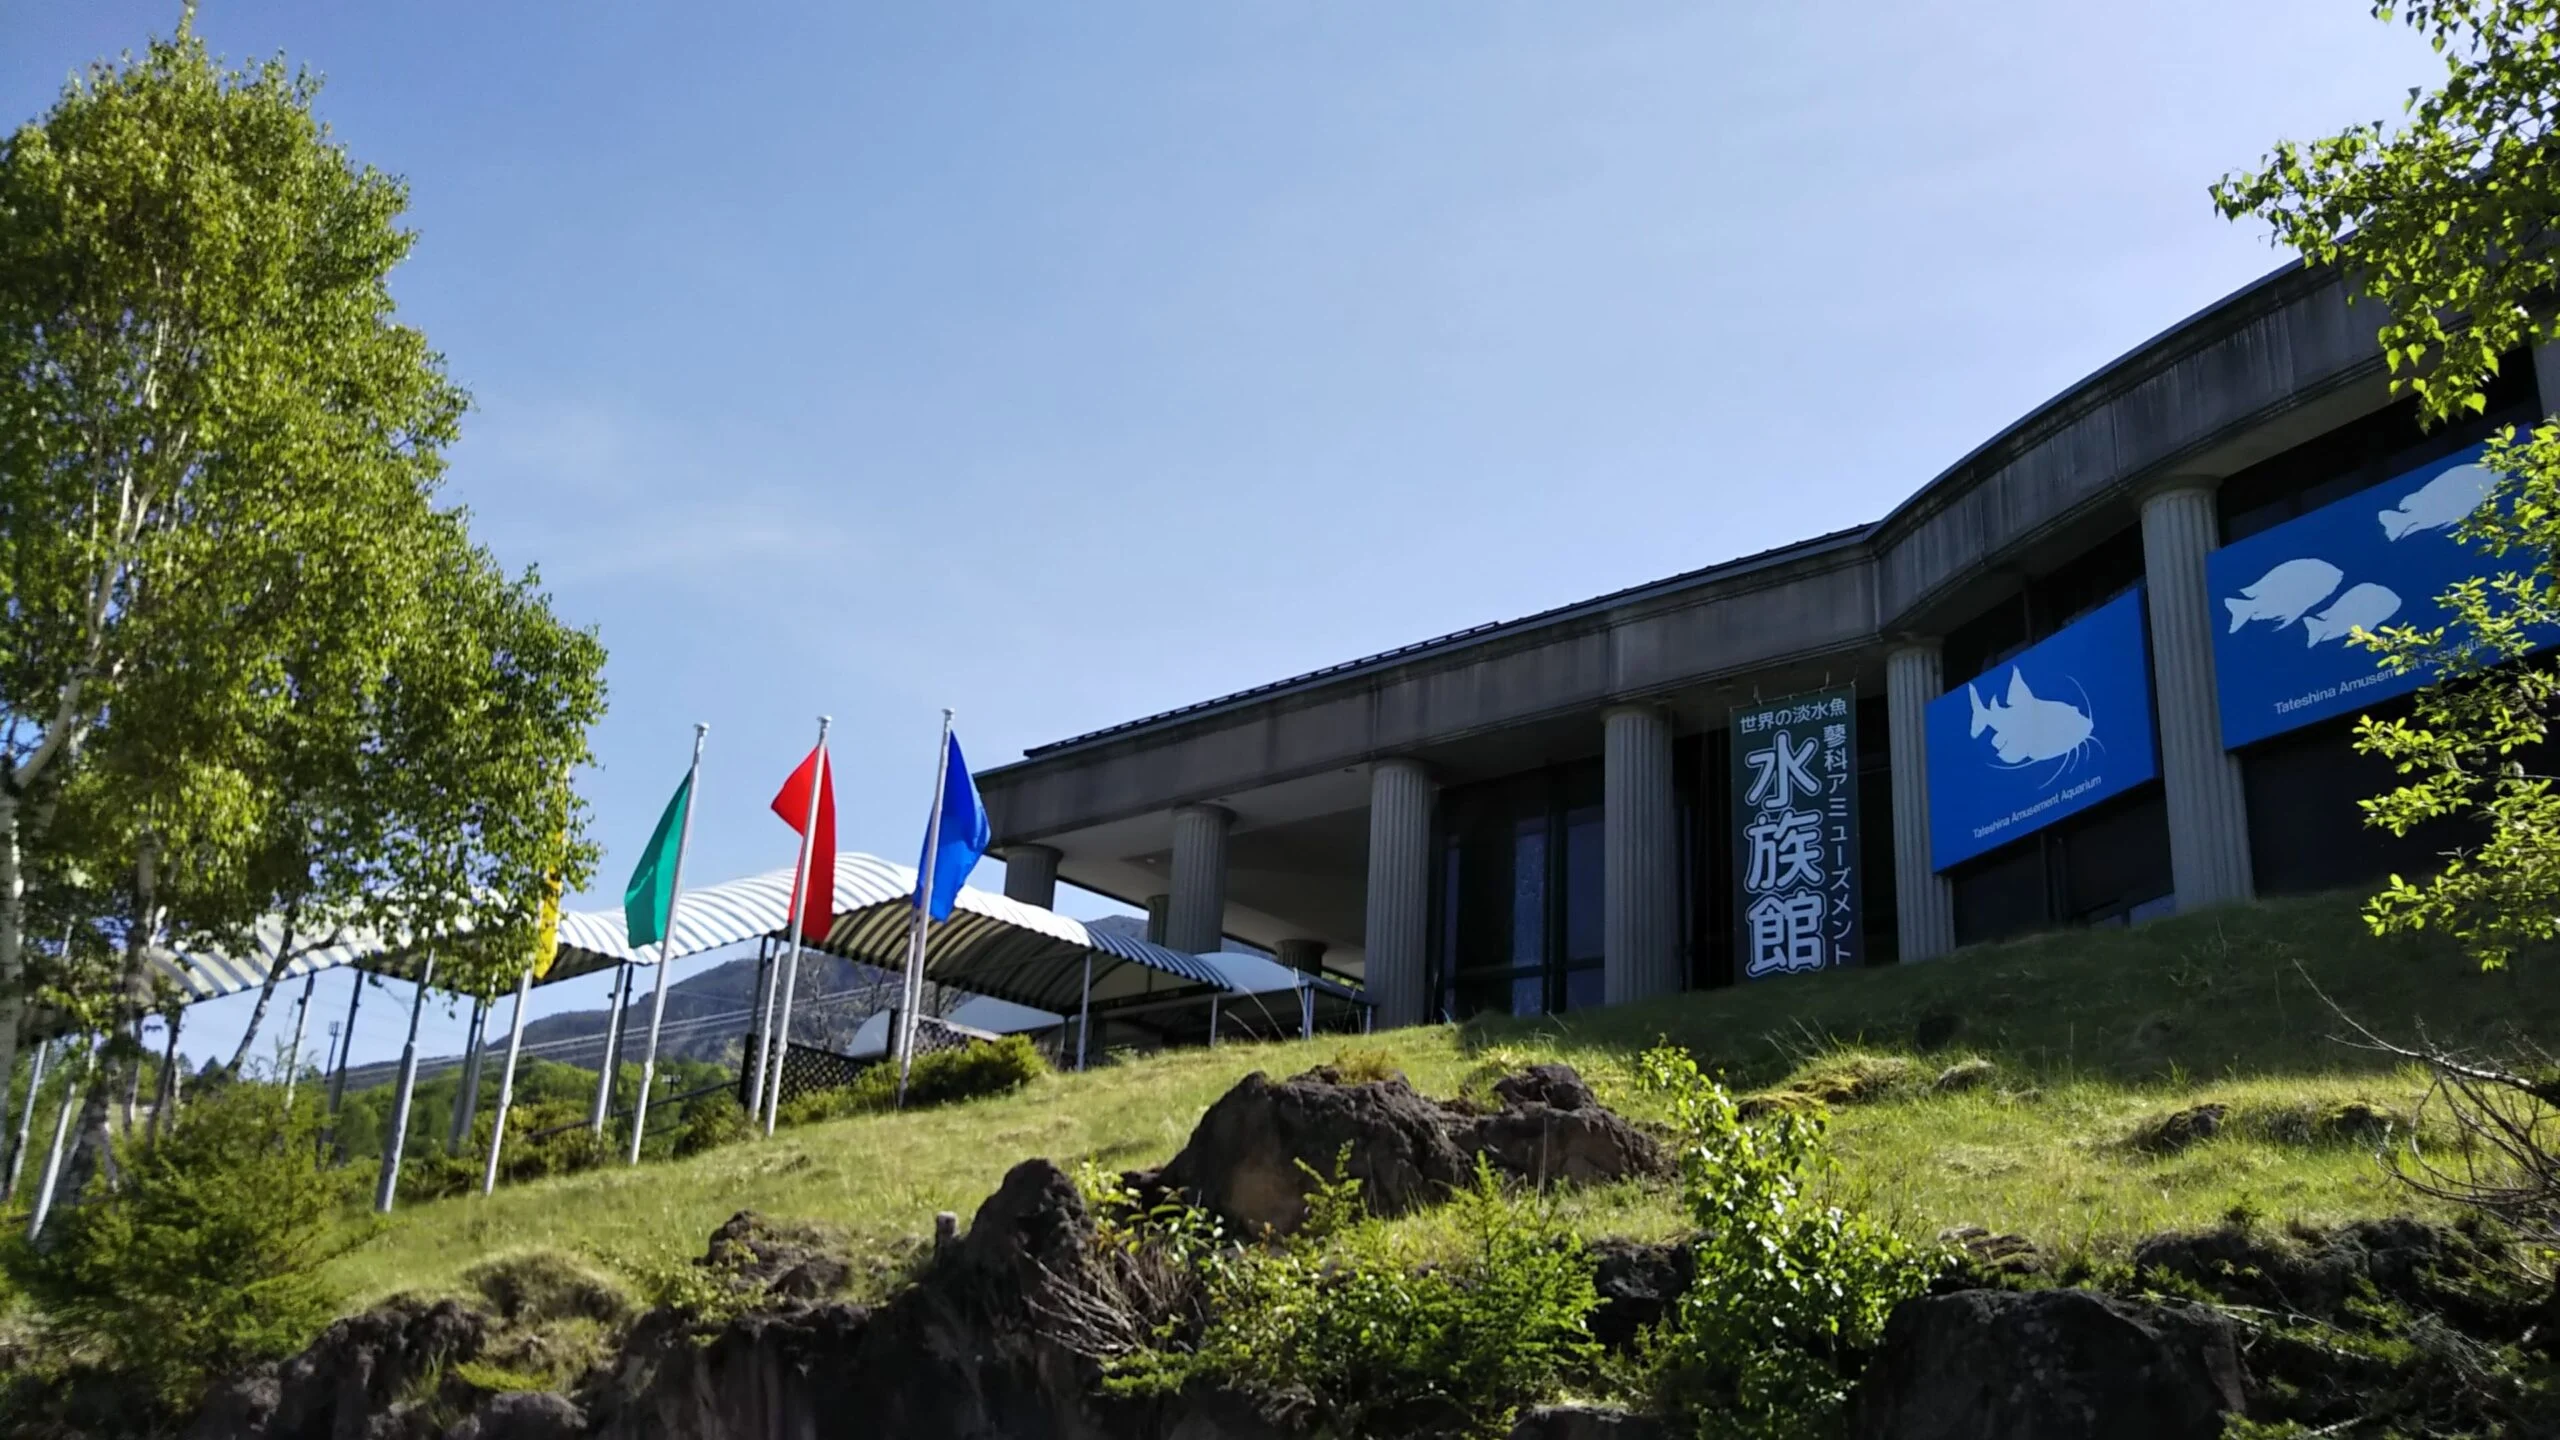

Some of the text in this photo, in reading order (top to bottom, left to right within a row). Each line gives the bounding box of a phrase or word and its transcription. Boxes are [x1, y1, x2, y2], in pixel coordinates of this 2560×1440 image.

[1740, 698, 1848, 735] 世界の淡水魚
[2273, 685, 2337, 715] Tateshina
[1972, 775, 2102, 839] Tateshina Amusement Aquarium
[1744, 730, 1826, 977] 水族館
[1822, 724, 1852, 965] 蓼科アミューズメント
